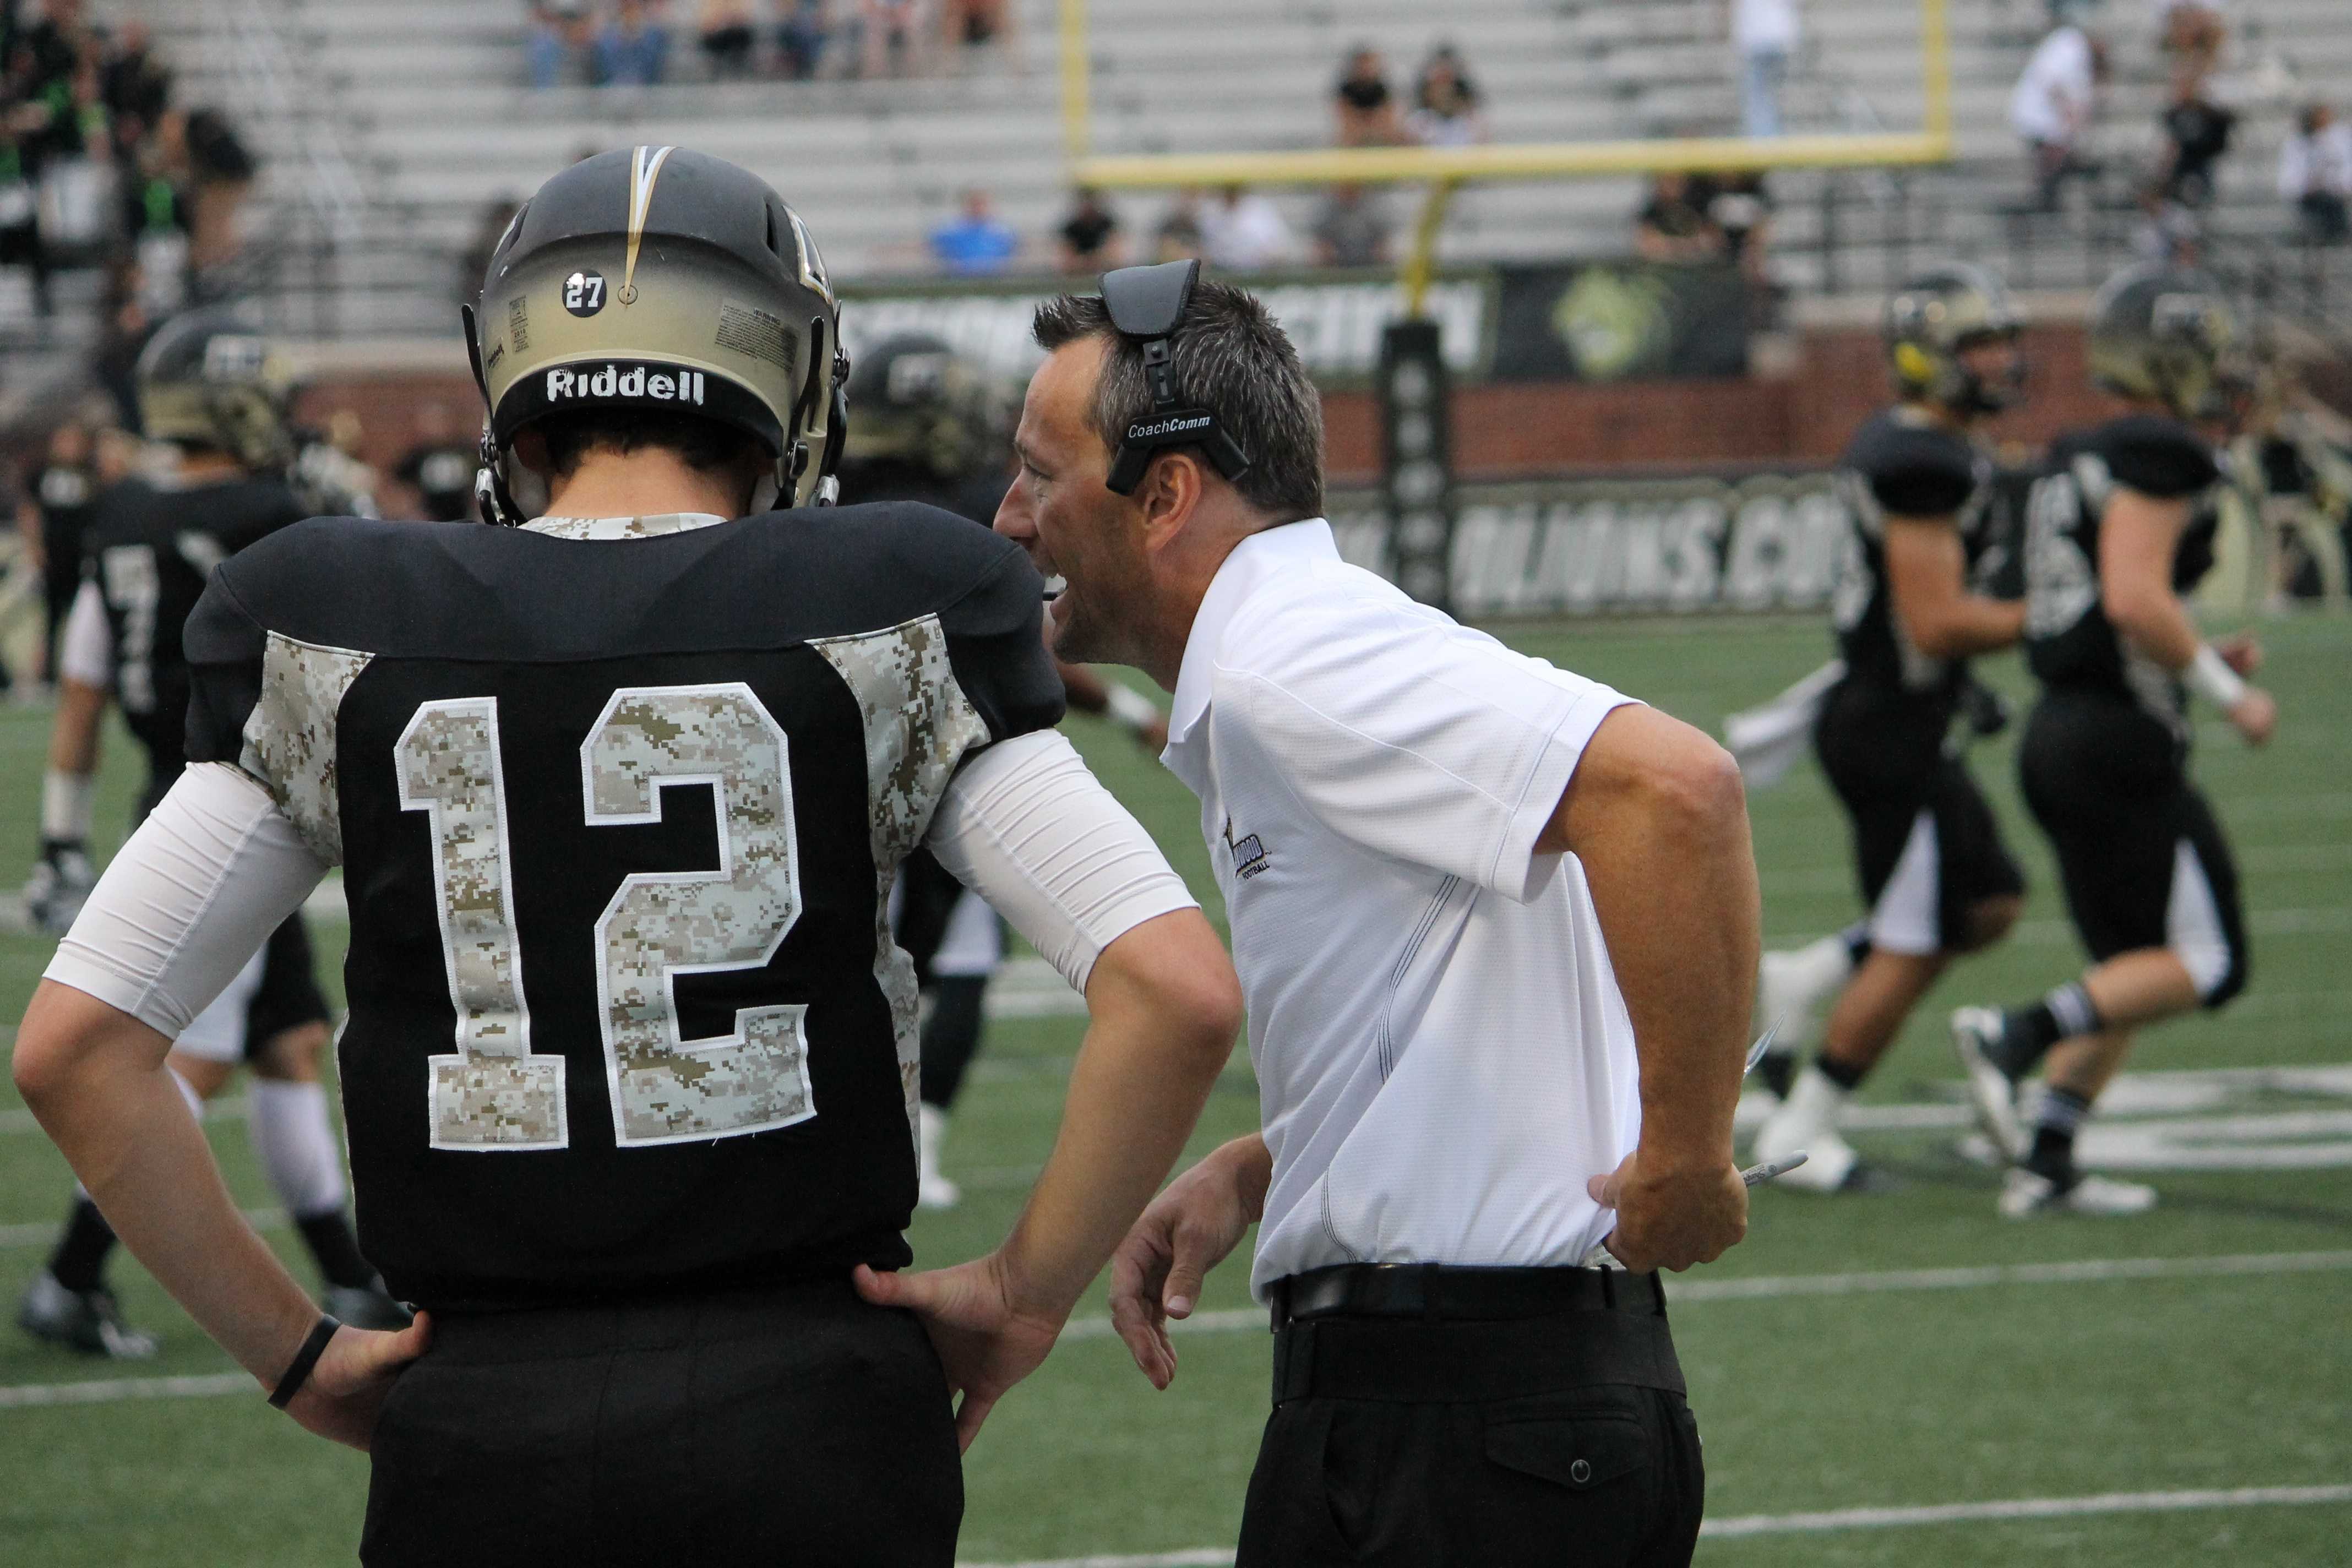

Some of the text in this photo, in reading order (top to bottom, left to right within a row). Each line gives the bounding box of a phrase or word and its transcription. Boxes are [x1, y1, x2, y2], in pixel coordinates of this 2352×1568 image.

[566, 273, 603, 308] 27
[753, 308, 780, 325] WARNING
[547, 364, 704, 406] Riddell
[1129, 416, 1211, 438] CoachComm
[393, 682, 817, 1153] 12
